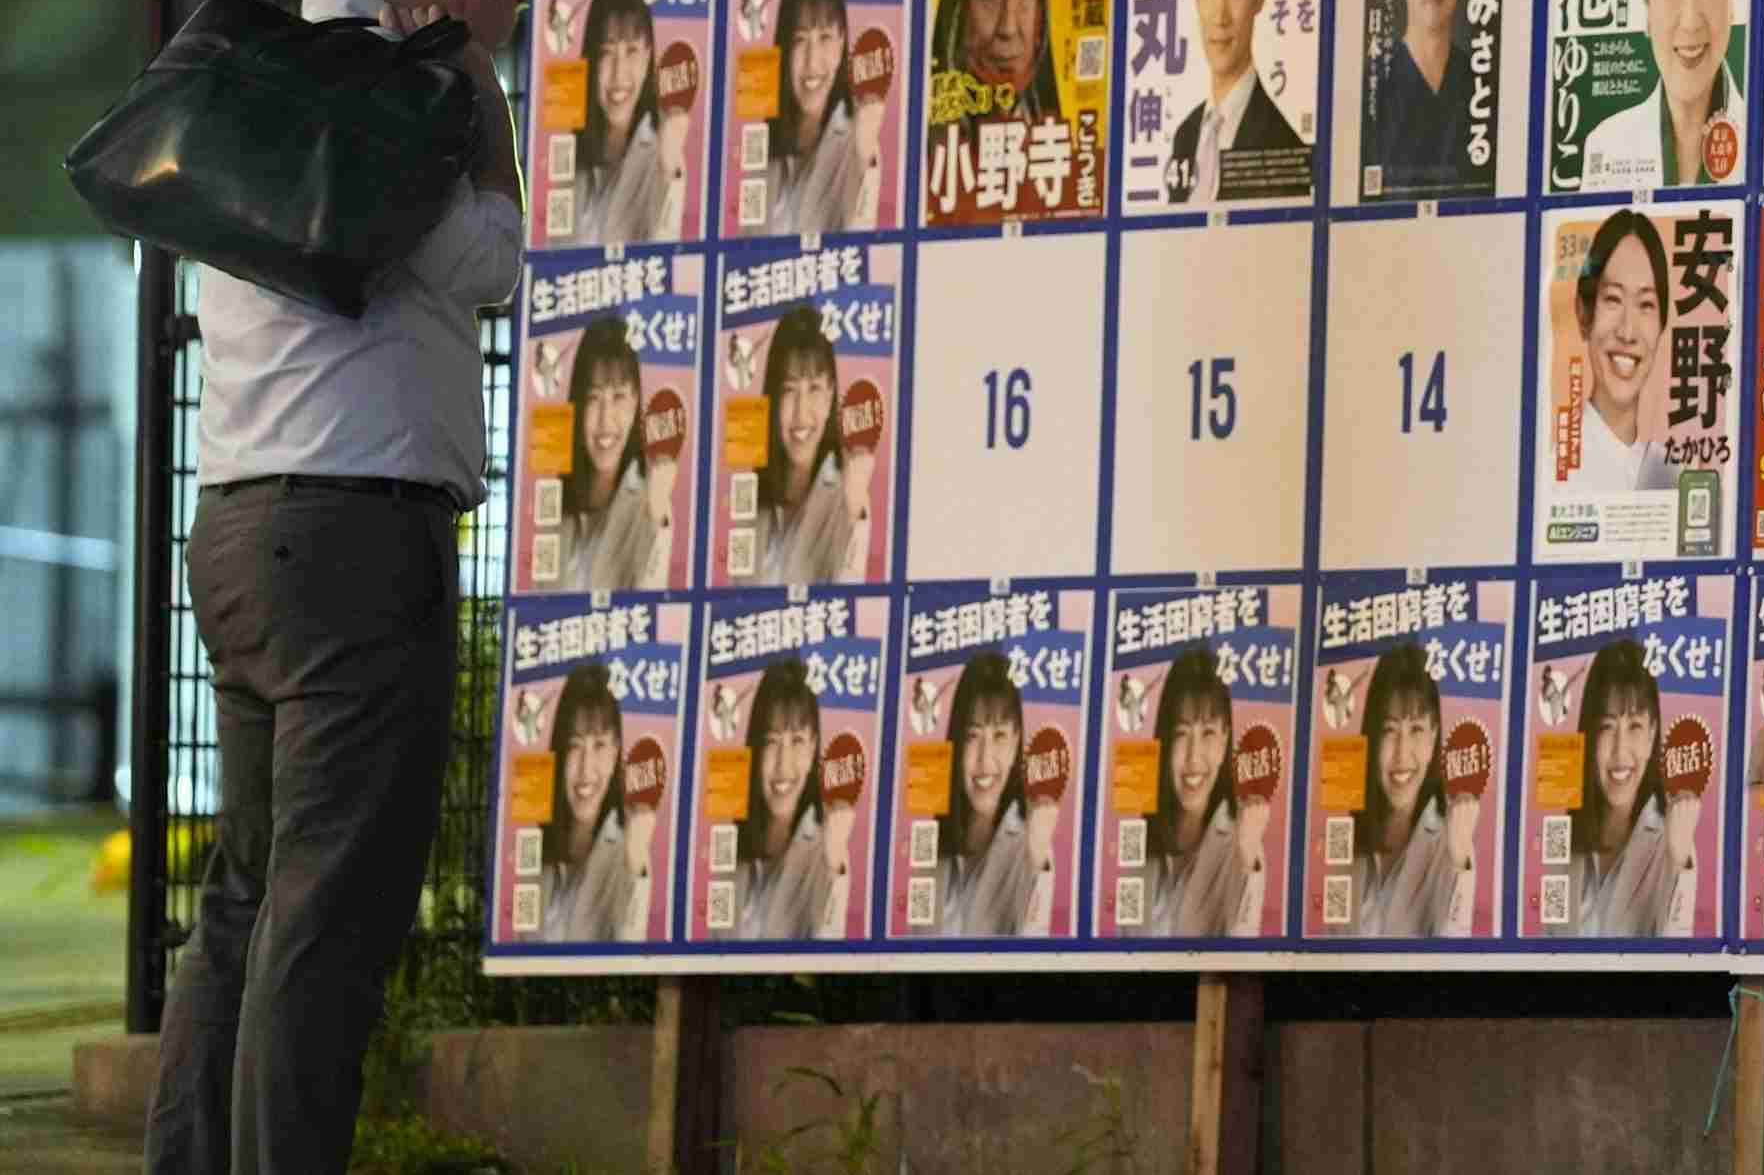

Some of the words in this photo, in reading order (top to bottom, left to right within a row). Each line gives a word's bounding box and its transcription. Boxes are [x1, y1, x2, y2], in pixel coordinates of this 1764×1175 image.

[1551, 36, 1590, 190] ゆりこ
[929, 115, 1073, 215] 小野寺
[1667, 209, 1734, 429] 安野
[983, 367, 1032, 450] 16
[1187, 357, 1237, 441] 15
[1398, 350, 1448, 434] 14
[1664, 435, 1731, 466] たかひろ
[1117, 588, 1260, 653] 生活困窮者を
[1322, 581, 1469, 649] 生活困窮者を
[1537, 576, 1689, 646] 生活困窮者を
[804, 652, 878, 695] なくせ!
[1007, 646, 1081, 689] なくせ!
[1216, 642, 1292, 686] なくせ!
[1424, 638, 1501, 682] なくせ!
[1642, 634, 1722, 678] なくせ!
[1665, 737, 1712, 775] 復活!
